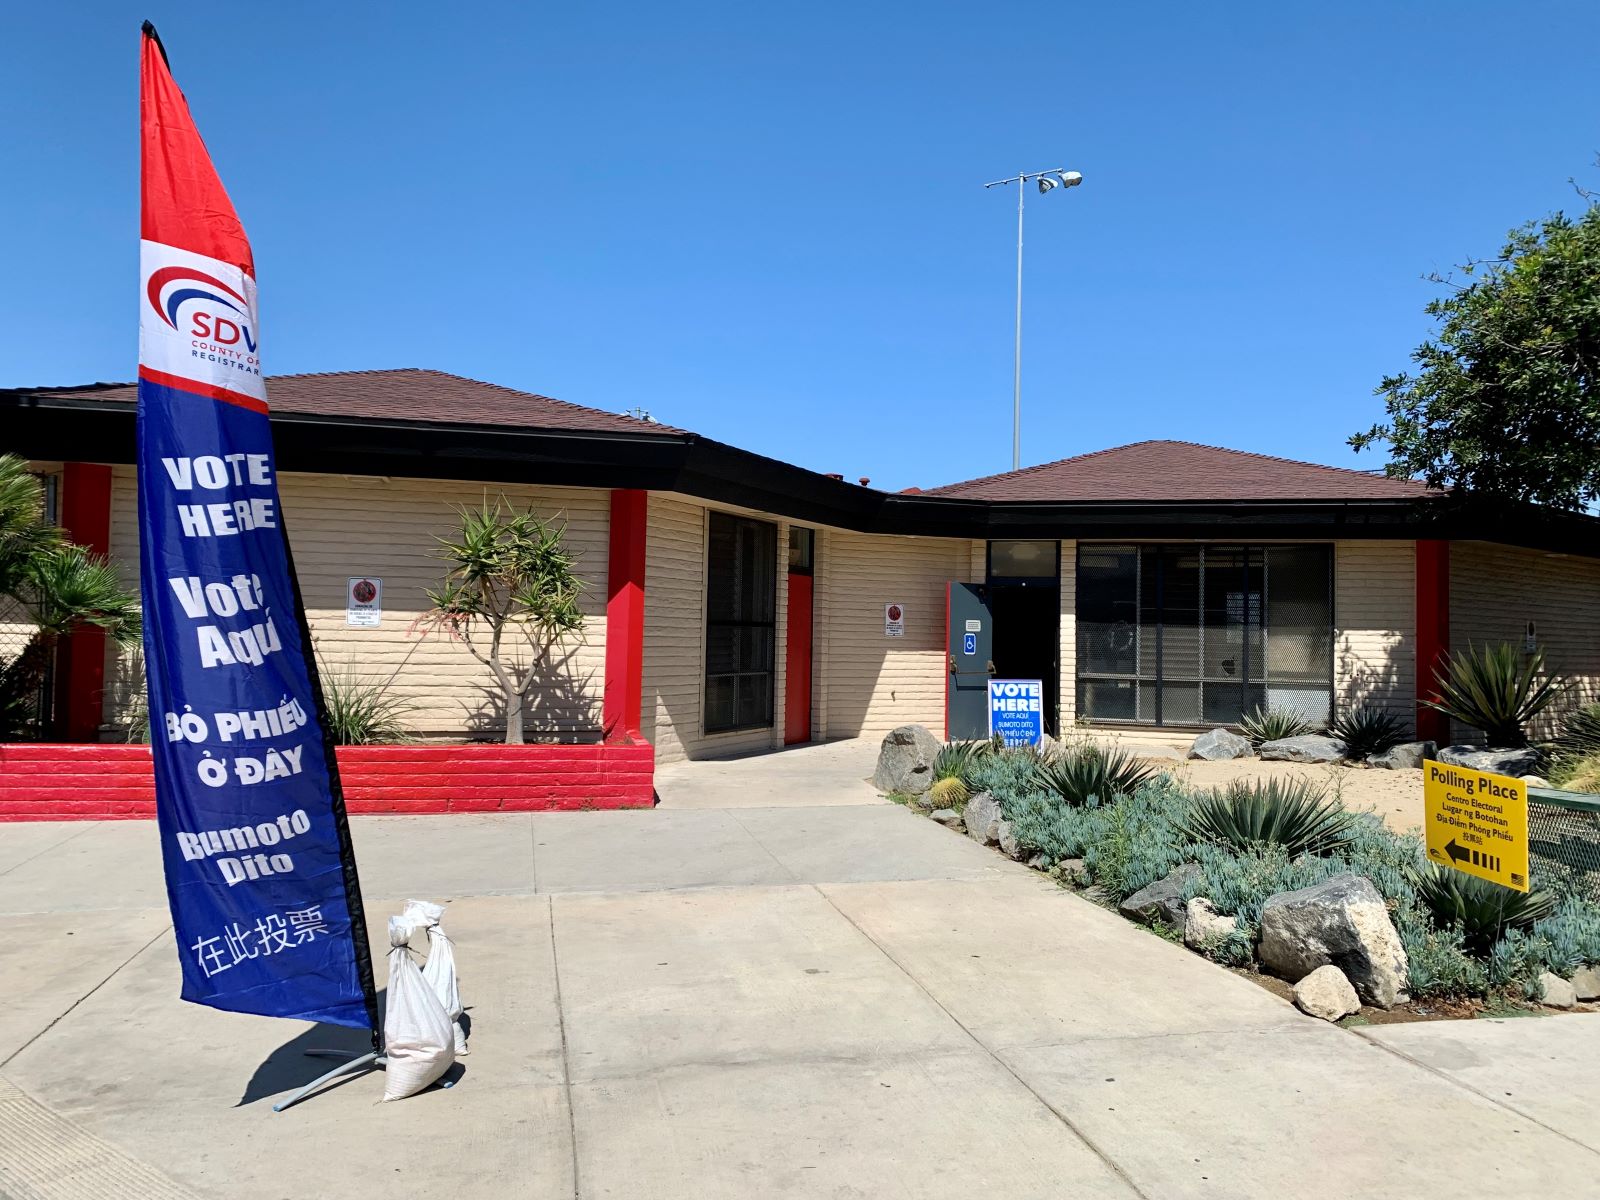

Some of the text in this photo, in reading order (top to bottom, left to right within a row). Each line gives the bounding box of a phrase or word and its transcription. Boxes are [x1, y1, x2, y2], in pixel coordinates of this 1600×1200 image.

[191, 340, 242, 360] COUNTY
[191, 349, 260, 376] REGISTRAR
[162, 453, 272, 490] VOTE
[177, 498, 276, 537] HERE
[196, 607, 283, 669] Aquí
[991, 683, 1040, 697] VOTE
[992, 698, 1040, 712] HERE
[165, 693, 308, 743] BỎ PHIẾU
[197, 744, 304, 787] Ở ĐÂY
[1431, 766, 1518, 800] Polling Place
[1442, 802, 1509, 827] Lugar ng Botohan
[1446, 792, 1503, 814] Centro Electoral
[177, 808, 311, 862] Bumoto
[216, 853, 295, 887] Dito
[191, 904, 330, 979] 在此投票
